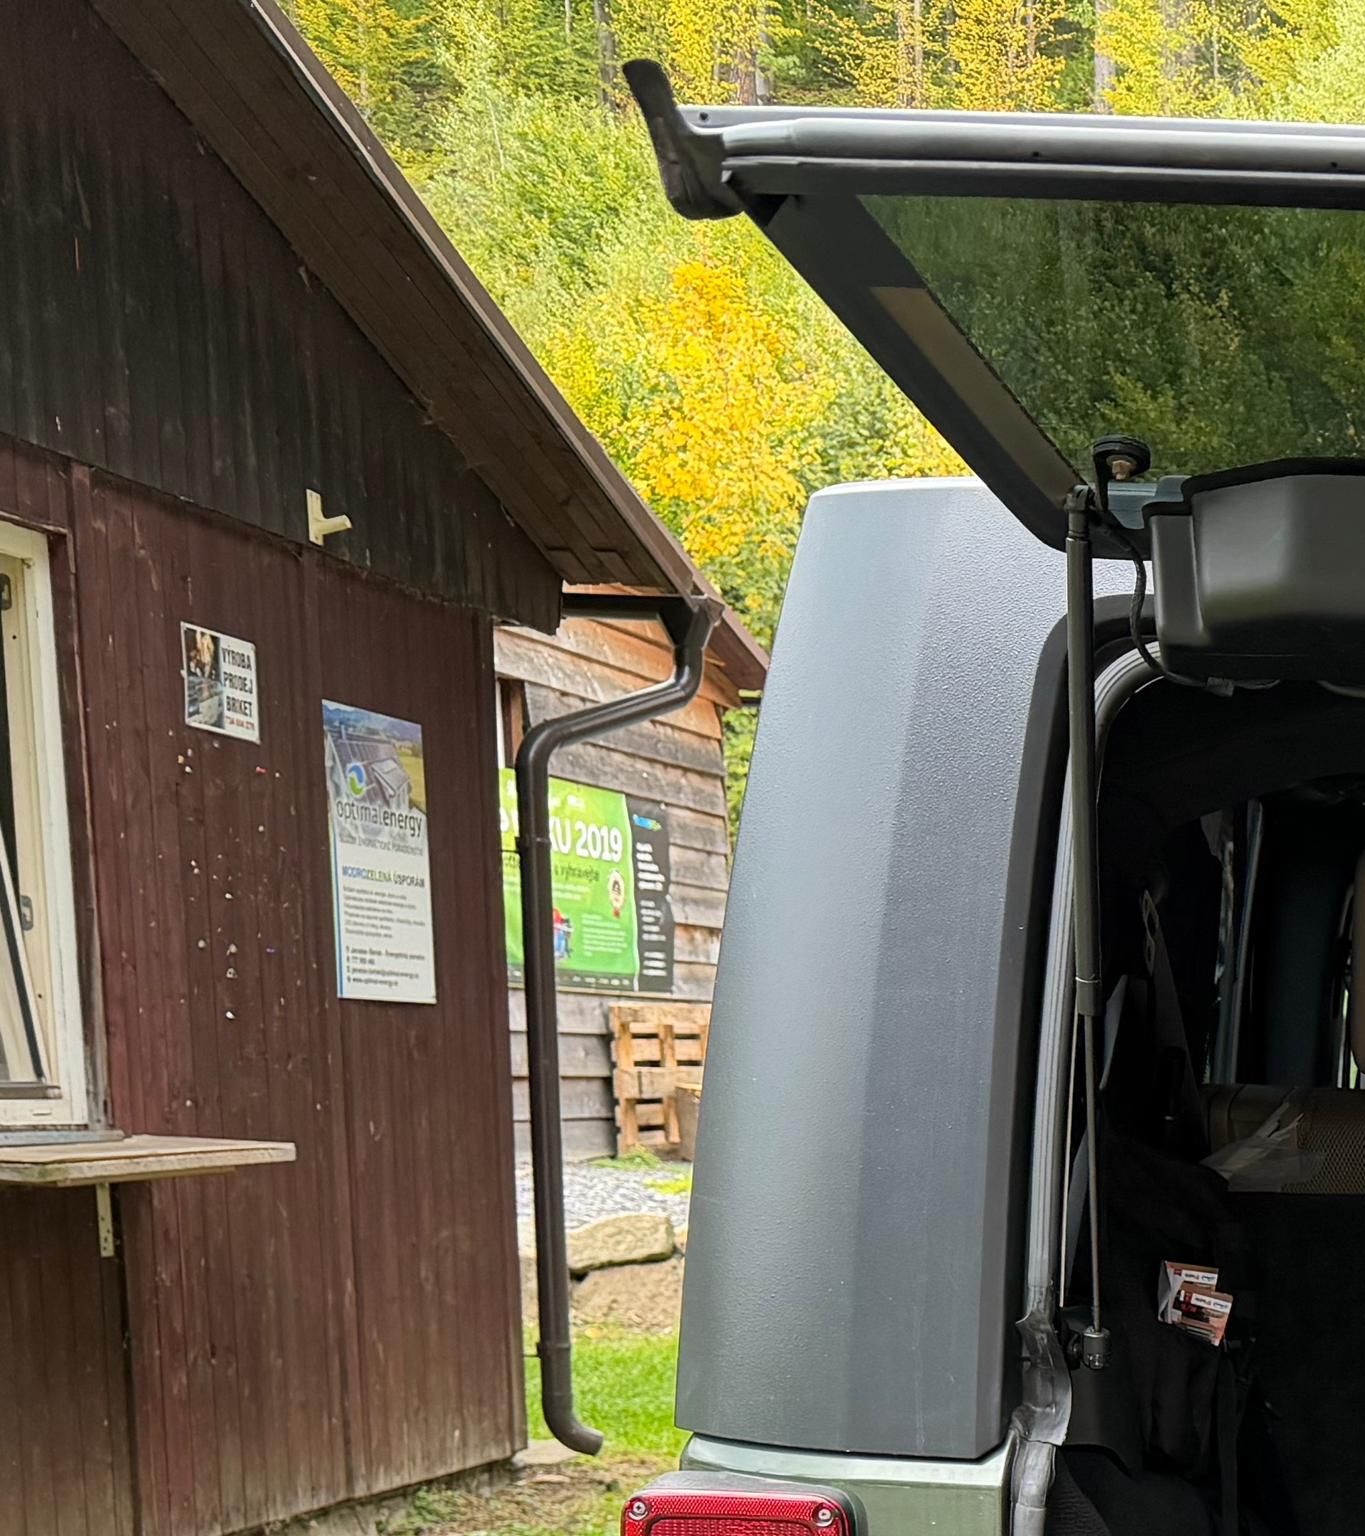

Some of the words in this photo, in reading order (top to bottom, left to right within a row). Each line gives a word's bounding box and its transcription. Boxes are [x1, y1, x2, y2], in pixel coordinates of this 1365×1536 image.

[223, 671, 253, 694] PRODEJ
[226, 695, 252, 718] BRIKET
[576, 823, 623, 864] 2019
